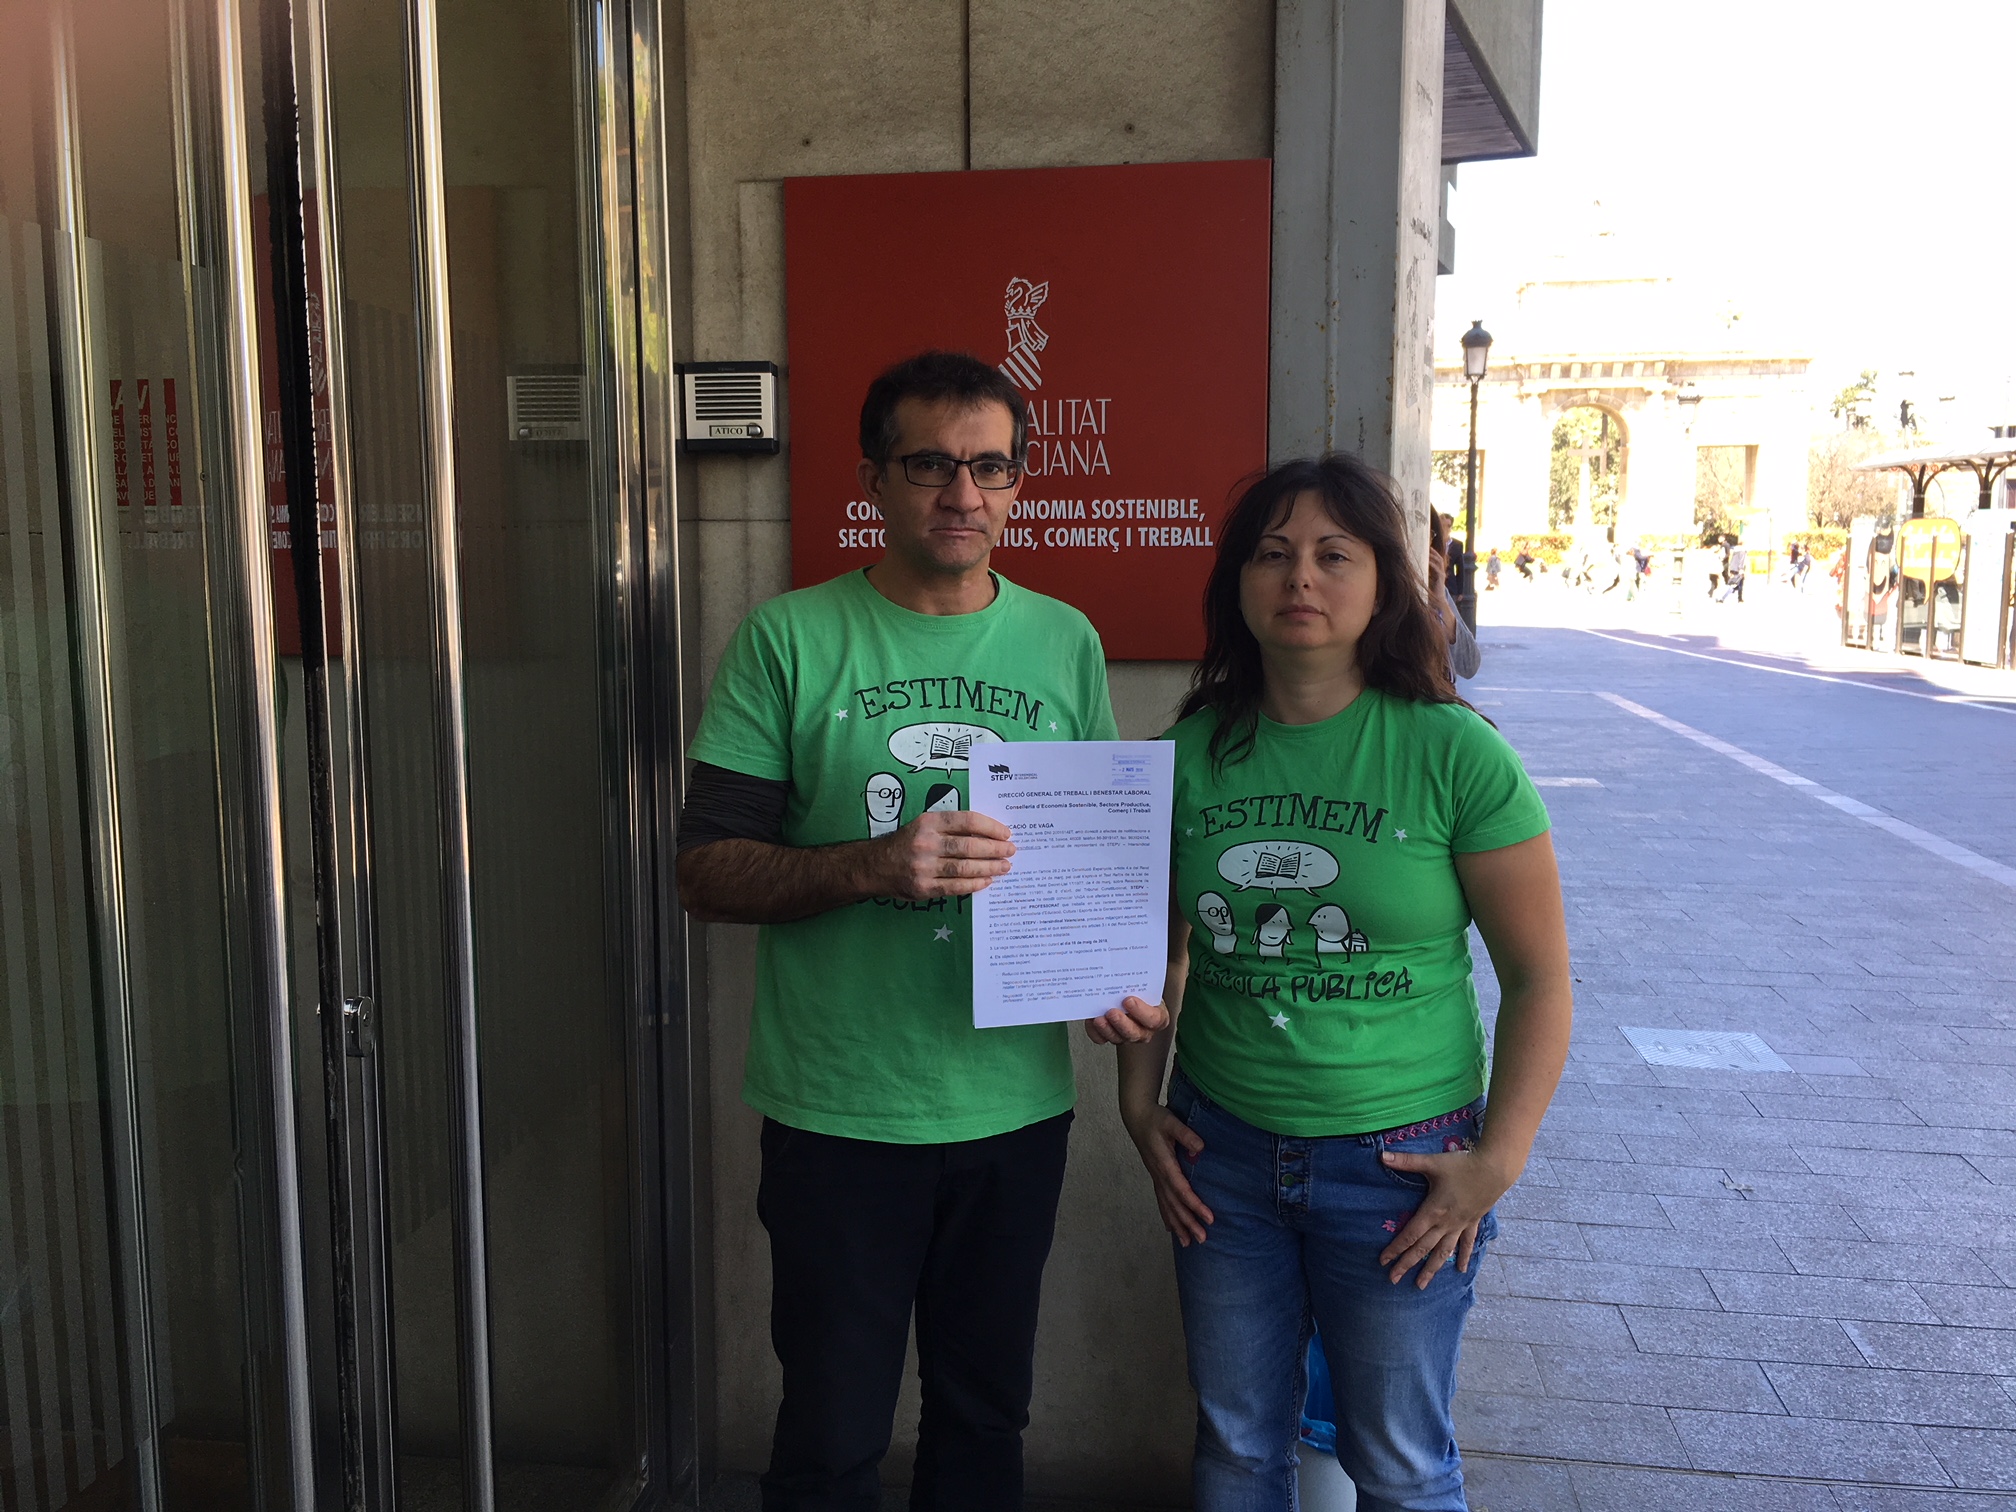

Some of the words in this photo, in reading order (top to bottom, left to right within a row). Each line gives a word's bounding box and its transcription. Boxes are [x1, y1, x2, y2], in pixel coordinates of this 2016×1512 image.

[1026, 398, 1112, 436] ALITAT
[1023, 440, 1111, 476] CIANA
[1008, 500, 1086, 520] ONOMIA
[1091, 498, 1206, 522] SOSTENIBLE,
[838, 528, 886, 548] SECTO
[1044, 527, 1120, 552] COMERÇ
[1126, 527, 1132, 547] I
[1138, 526, 1214, 547] TREBALL
[854, 676, 1044, 731] ESTIMEM
[1199, 792, 1388, 844] ESTIMEM
[1290, 966, 1413, 1002] PÚBLICA
